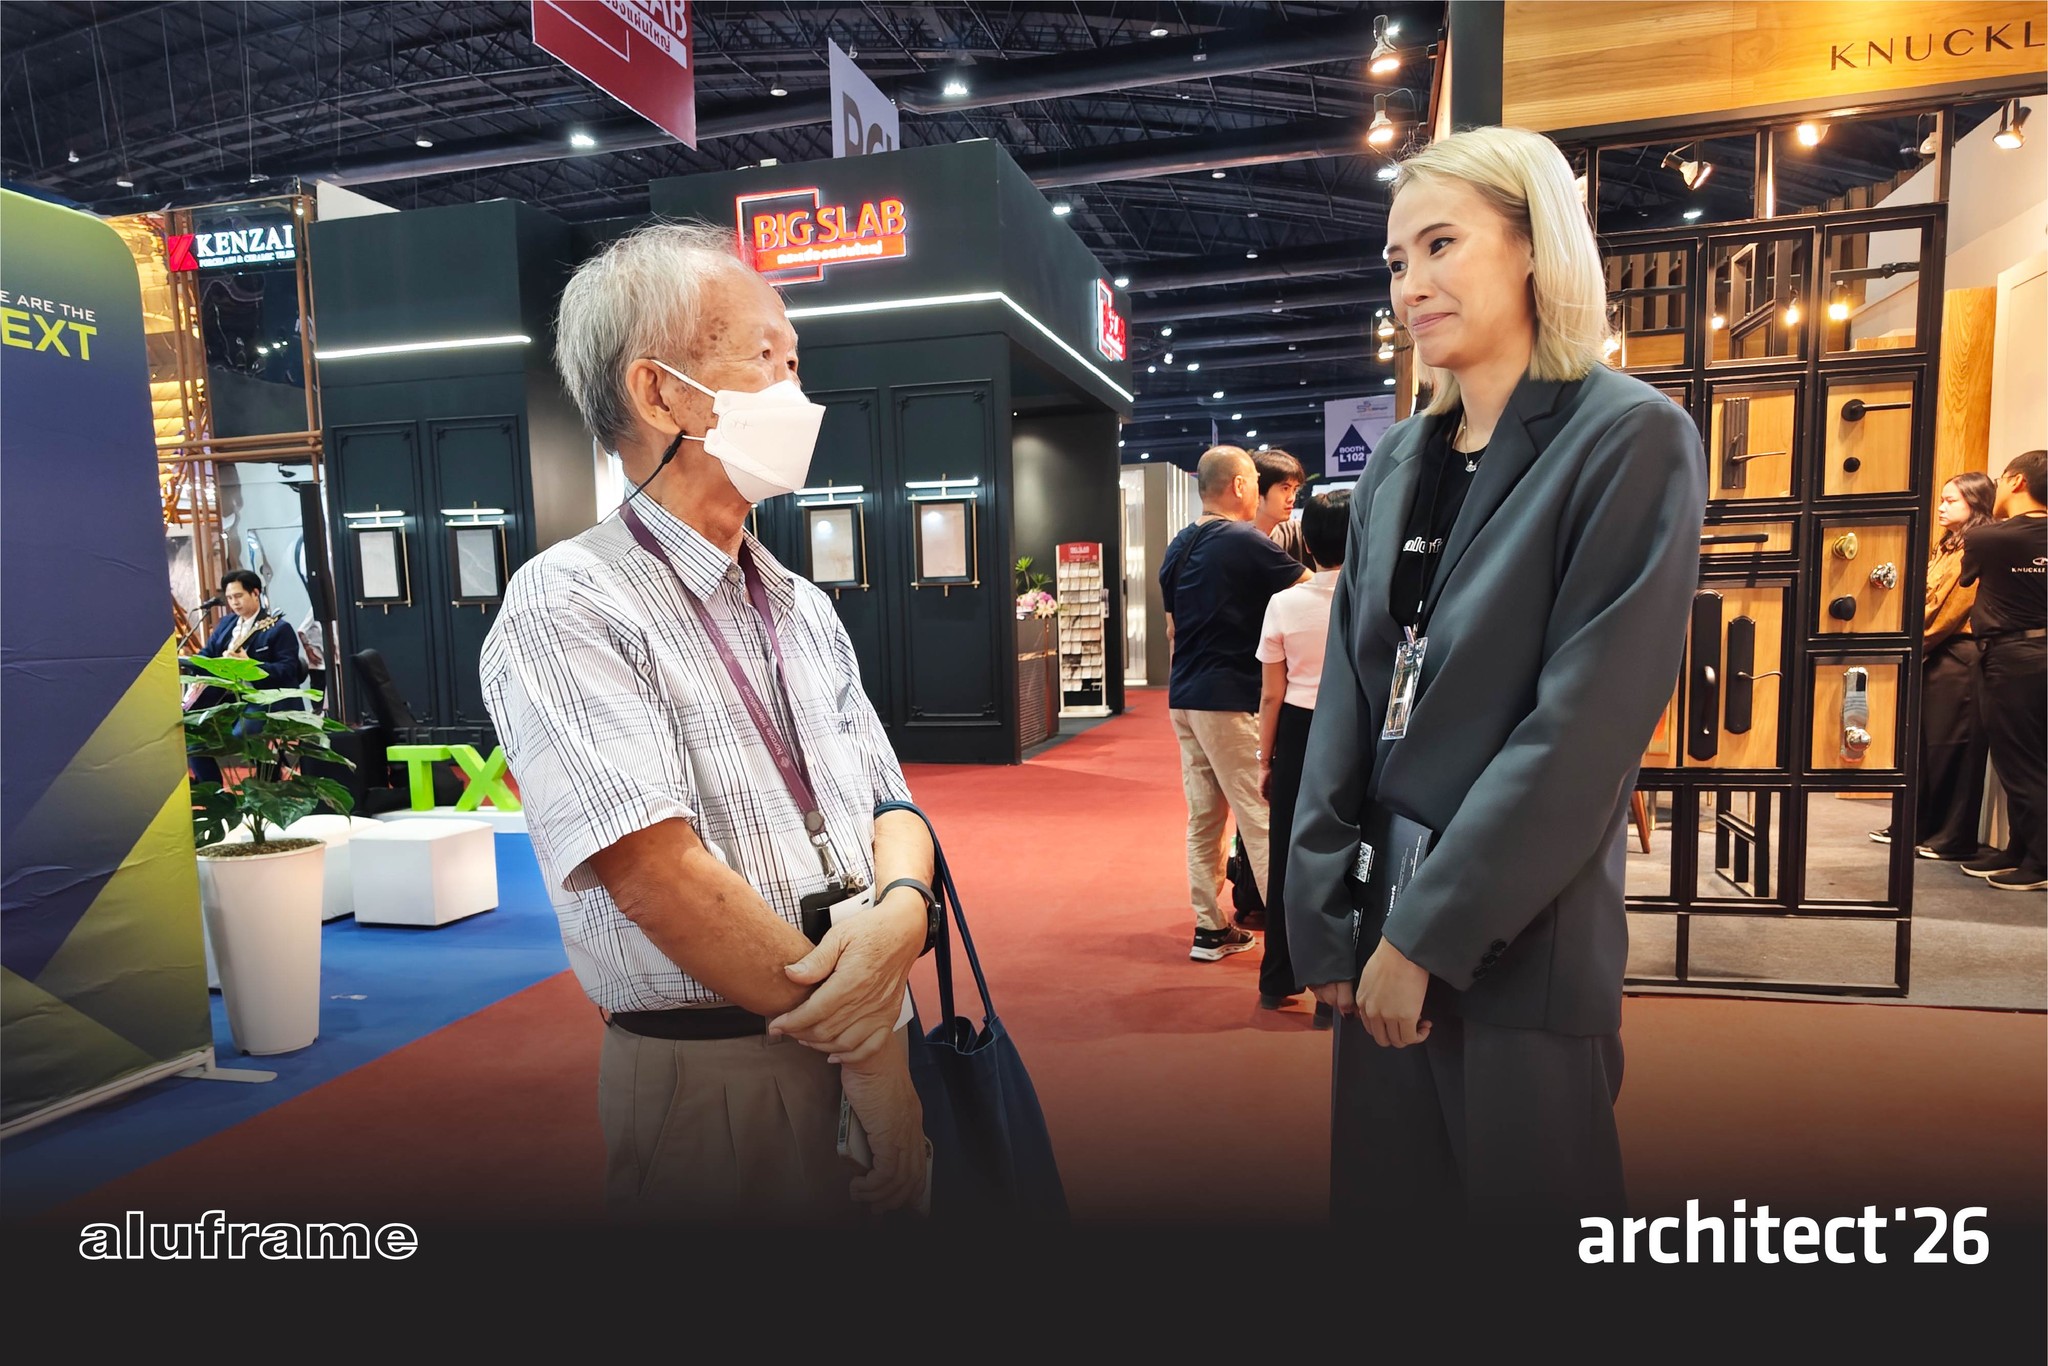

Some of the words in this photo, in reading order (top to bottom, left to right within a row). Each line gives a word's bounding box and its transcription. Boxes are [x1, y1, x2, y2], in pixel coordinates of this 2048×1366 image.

[1831, 21, 2046, 71] KNUCKL
[195, 225, 295, 257] KENZAI
[753, 211, 814, 250] BIG
[816, 200, 907, 243] SLAB
[17, 294, 55, 313] ARE
[59, 303, 96, 322] THE
[0, 306, 97, 361] EXT
[1339, 445, 1365, 454] BOOTH
[1339, 453, 1365, 463] L102
[742, 685, 769, 728] International
[765, 727, 784, 756] Norcote
